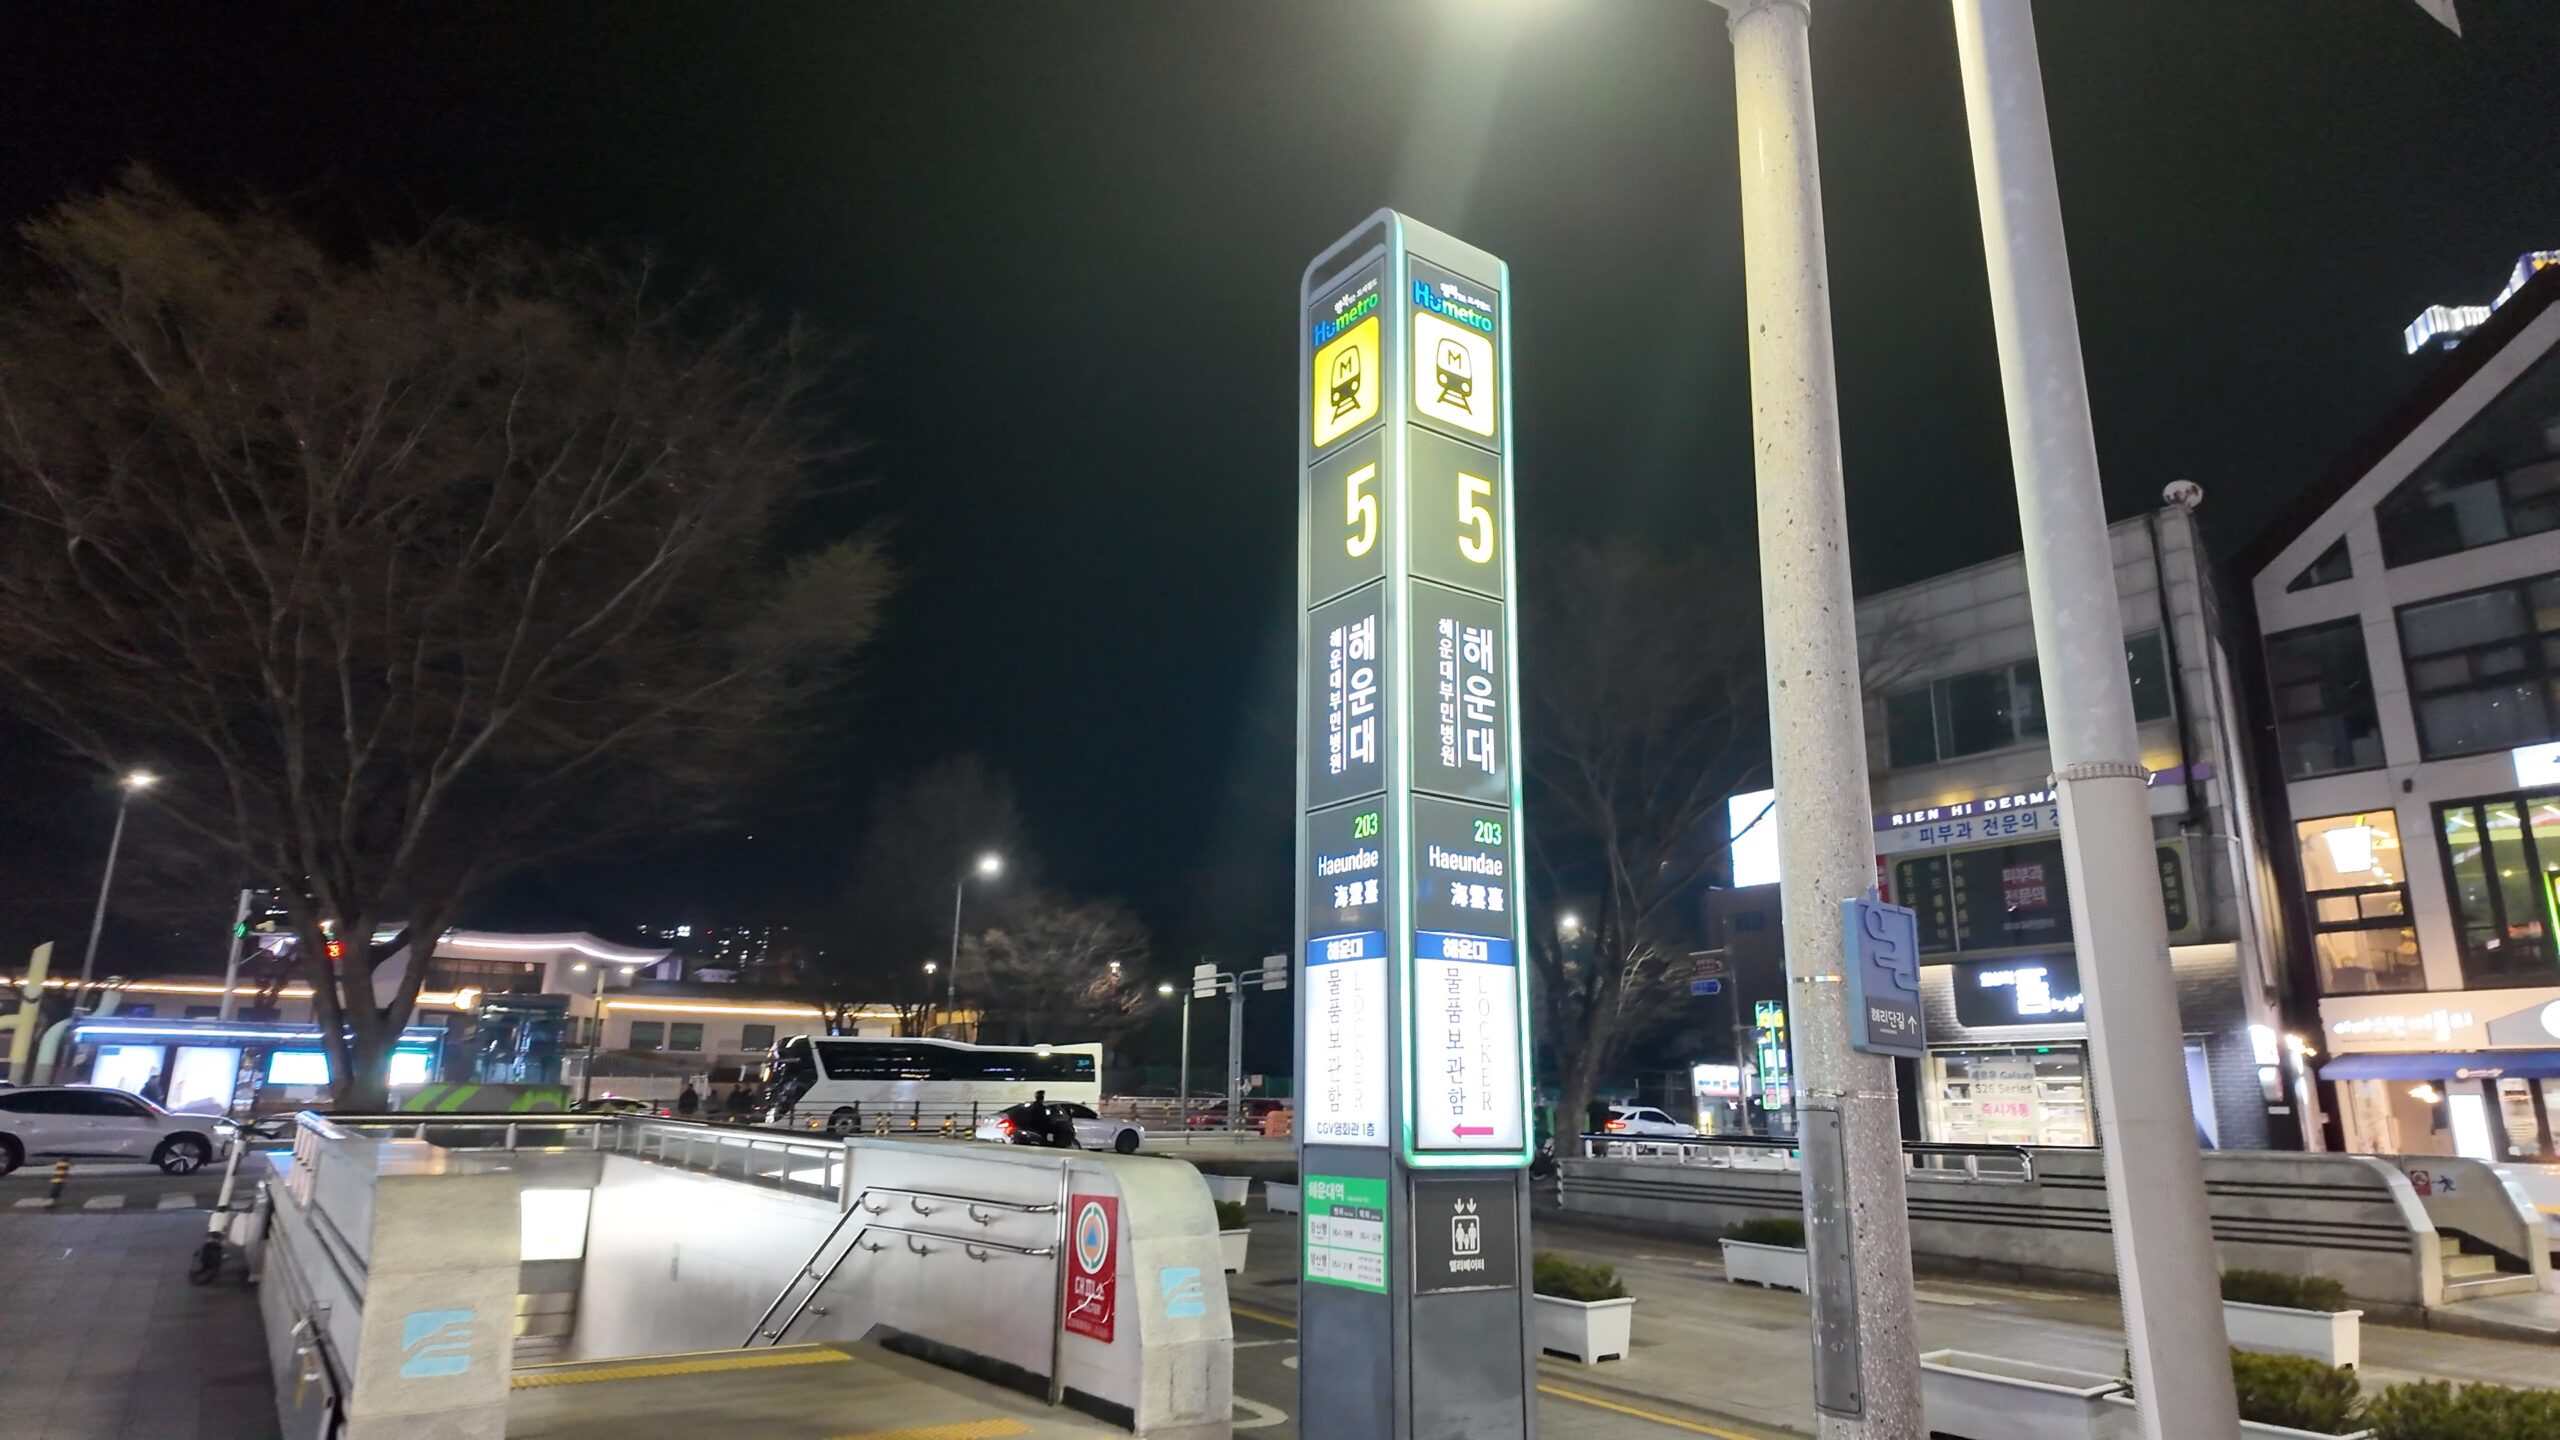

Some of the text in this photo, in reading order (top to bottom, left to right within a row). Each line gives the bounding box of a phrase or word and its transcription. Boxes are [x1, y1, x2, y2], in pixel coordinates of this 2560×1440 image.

[1345, 461, 1378, 558] 5
[1457, 471, 1494, 564] 5
[1329, 627, 1342, 775] 해운대부민병원
[1349, 614, 1377, 763] 해운대
[1438, 618, 1455, 767] 해운대부민병원
[1463, 627, 1496, 775] 해운대
[1354, 813, 1379, 839] 203
[1891, 809, 1939, 826] RIEN
[1951, 803, 1972, 817] HI
[1919, 823, 1973, 845] 피부과
[1983, 810, 2038, 837] 전문의
[1474, 820, 1502, 845] 203
[1318, 848, 1379, 876] Haeundae
[1429, 845, 1503, 876] Haeundae
[2002, 866, 2045, 884] 피부과
[2004, 887, 2047, 907] 전문의
[1871, 1007, 1905, 1030] 해리단길
[1327, 969, 1342, 1113] 물품보관함
[1354, 972, 1364, 1109] LOCKER
[1445, 967, 1466, 1116] 물품보관함
[1478, 975, 1493, 1111] LOCKER
[1308, 1181, 1345, 1201] 해운대역
[1449, 1258, 1485, 1272] 엘리베이터
